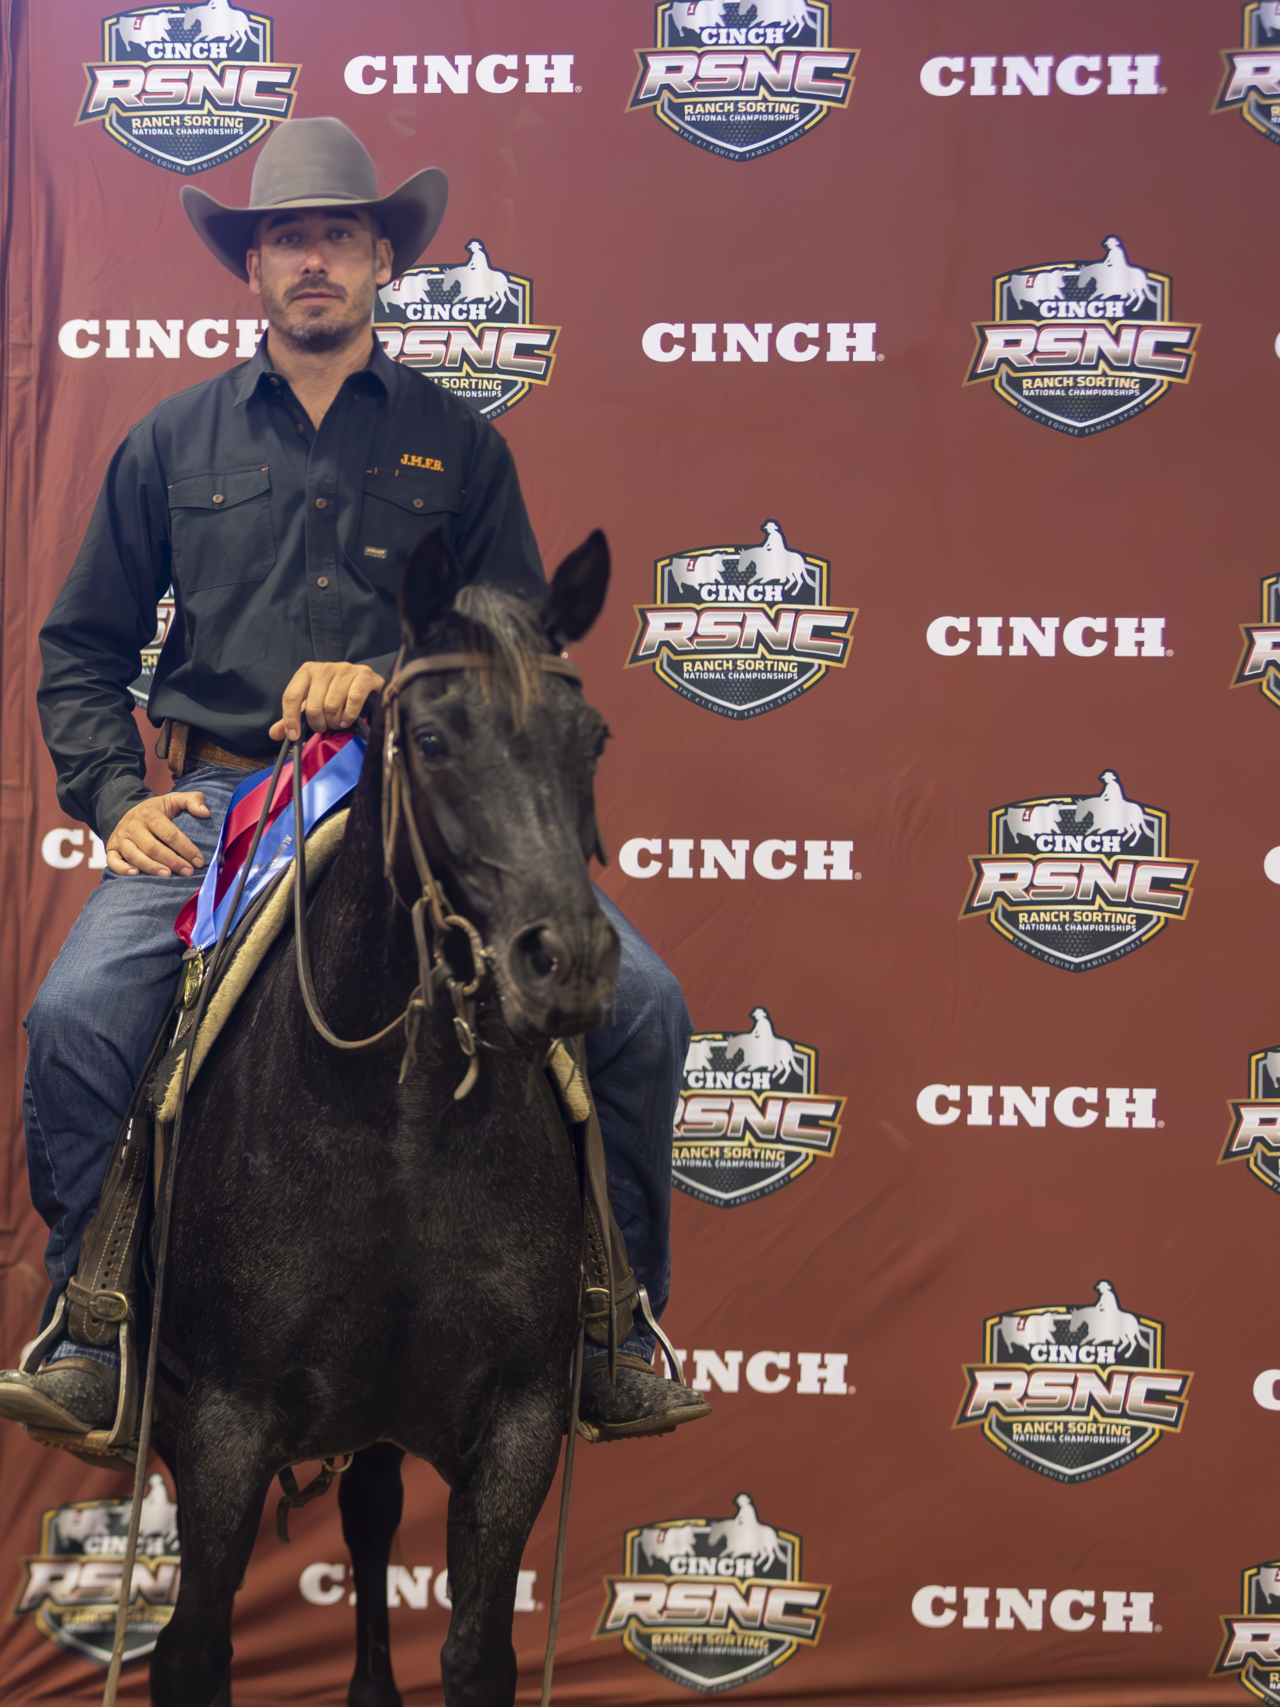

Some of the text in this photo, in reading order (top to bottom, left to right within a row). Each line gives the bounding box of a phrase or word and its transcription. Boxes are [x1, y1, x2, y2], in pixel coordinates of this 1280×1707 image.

[701, 27, 784, 44] CINCH
[147, 42, 228, 59] CINCH
[344, 55, 573, 94] CINCH
[638, 51, 850, 100] RSNC
[920, 55, 1158, 96] CINCH
[86, 66, 292, 114] RSNC
[684, 101, 800, 115] RANCH SORTING
[132, 115, 244, 128] RANCH SORTING
[730, 114, 800, 122] CHAMPIONSHIPS
[132, 128, 174, 136] NATIONAL
[679, 129, 693, 141] THE
[709, 144, 740, 160] EQUINE
[746, 144, 775, 159] FAMILY
[780, 129, 804, 146] SPORT
[127, 143, 140, 154] THE
[157, 158, 186, 174] EQUINE
[192, 158, 221, 172] FAMILY
[224, 143, 248, 159] SPORT
[406, 304, 487, 320] CINCH
[1040, 301, 1124, 318] CINCH
[642, 323, 876, 362] CINCH
[975, 325, 1191, 374] RSNC
[442, 378, 502, 390] SORTING
[1022, 376, 1140, 389] RANCH SORTING
[1023, 388, 1140, 397] NATIONAL CHAMPIONSHIPS
[486, 405, 507, 419] PORT
[1017, 404, 1031, 416] THE
[1048, 419, 1079, 436] EQUINE
[1085, 420, 1115, 434] FAMILY
[1120, 404, 1144, 421] SPORT
[700, 585, 783, 601] CINCH
[637, 610, 848, 657] RSNC
[927, 616, 1165, 656] CINCH
[683, 660, 798, 673] RANCH SORTING
[684, 672, 798, 680] NATIONAL CHAMPIONSHIPS
[678, 687, 692, 698] THE
[708, 702, 738, 718] EQUINE
[744, 703, 774, 718] FAMILY
[778, 688, 802, 704] SPORT
[1036, 835, 1121, 852] CINCH
[619, 838, 853, 880] CINCH
[971, 860, 1188, 909] RSNC
[1019, 911, 1136, 925] RANCH SORTING
[1065, 924, 1136, 932] CHAMPIONSHIPS
[1013, 938, 1027, 950] THE
[1044, 954, 1075, 971] EQUINE
[1082, 955, 1111, 970] FAMILY
[1116, 940, 1140, 957] SPORT
[689, 1072, 771, 1089] CINCH
[917, 1084, 1156, 1128] CINCH
[672, 1148, 785, 1161] RANCH SORTING
[1031, 1345, 1116, 1363] CINCH
[965, 1369, 1183, 1422] RSNC
[1012, 1422, 1131, 1437] RANCH SORTING
[1013, 1434, 1131, 1444] NATIONAL CHAMPIONSHIPS
[670, 1557, 754, 1576] CINCH
[21, 1562, 181, 1608] RSN
[605, 1580, 820, 1634] RSNC
[911, 1585, 1153, 1632] CINCH
[652, 1633, 769, 1649] RANCH SORTING
